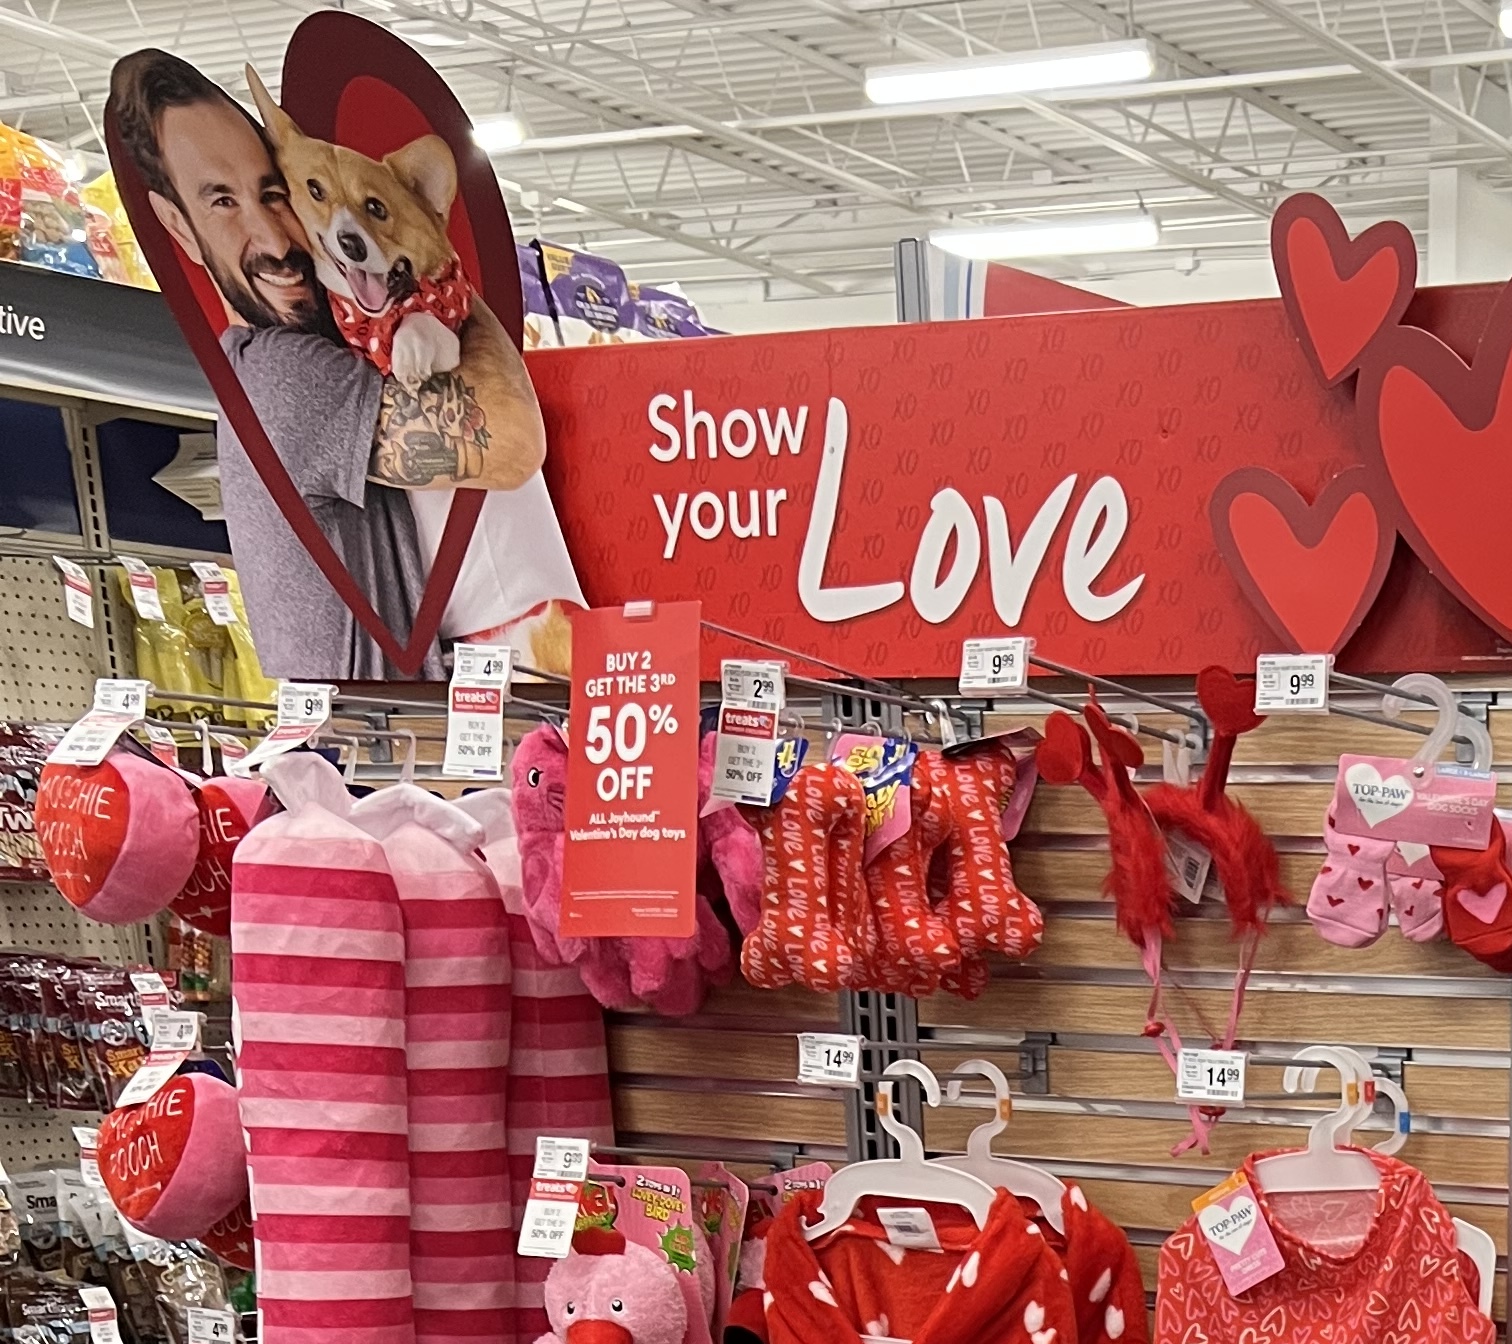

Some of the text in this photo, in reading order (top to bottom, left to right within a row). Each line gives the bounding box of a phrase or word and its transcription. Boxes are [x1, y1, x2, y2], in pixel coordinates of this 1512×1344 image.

[648, 389, 809, 462] Show
[653, 487, 787, 559] your
[798, 397, 1146, 628] Love
[606, 650, 652, 673] BUY 2
[585, 673, 676, 698] GET THE 3RD
[725, 712, 759, 728] treats
[584, 702, 679, 765] 50%
[596, 765, 654, 802] OFF
[589, 812, 606, 825] ALL
[640, 826, 660, 842] dog
[662, 828, 686, 841] toys
[636, 1174, 645, 1187] 2
[644, 1203, 670, 1222] BIRD
